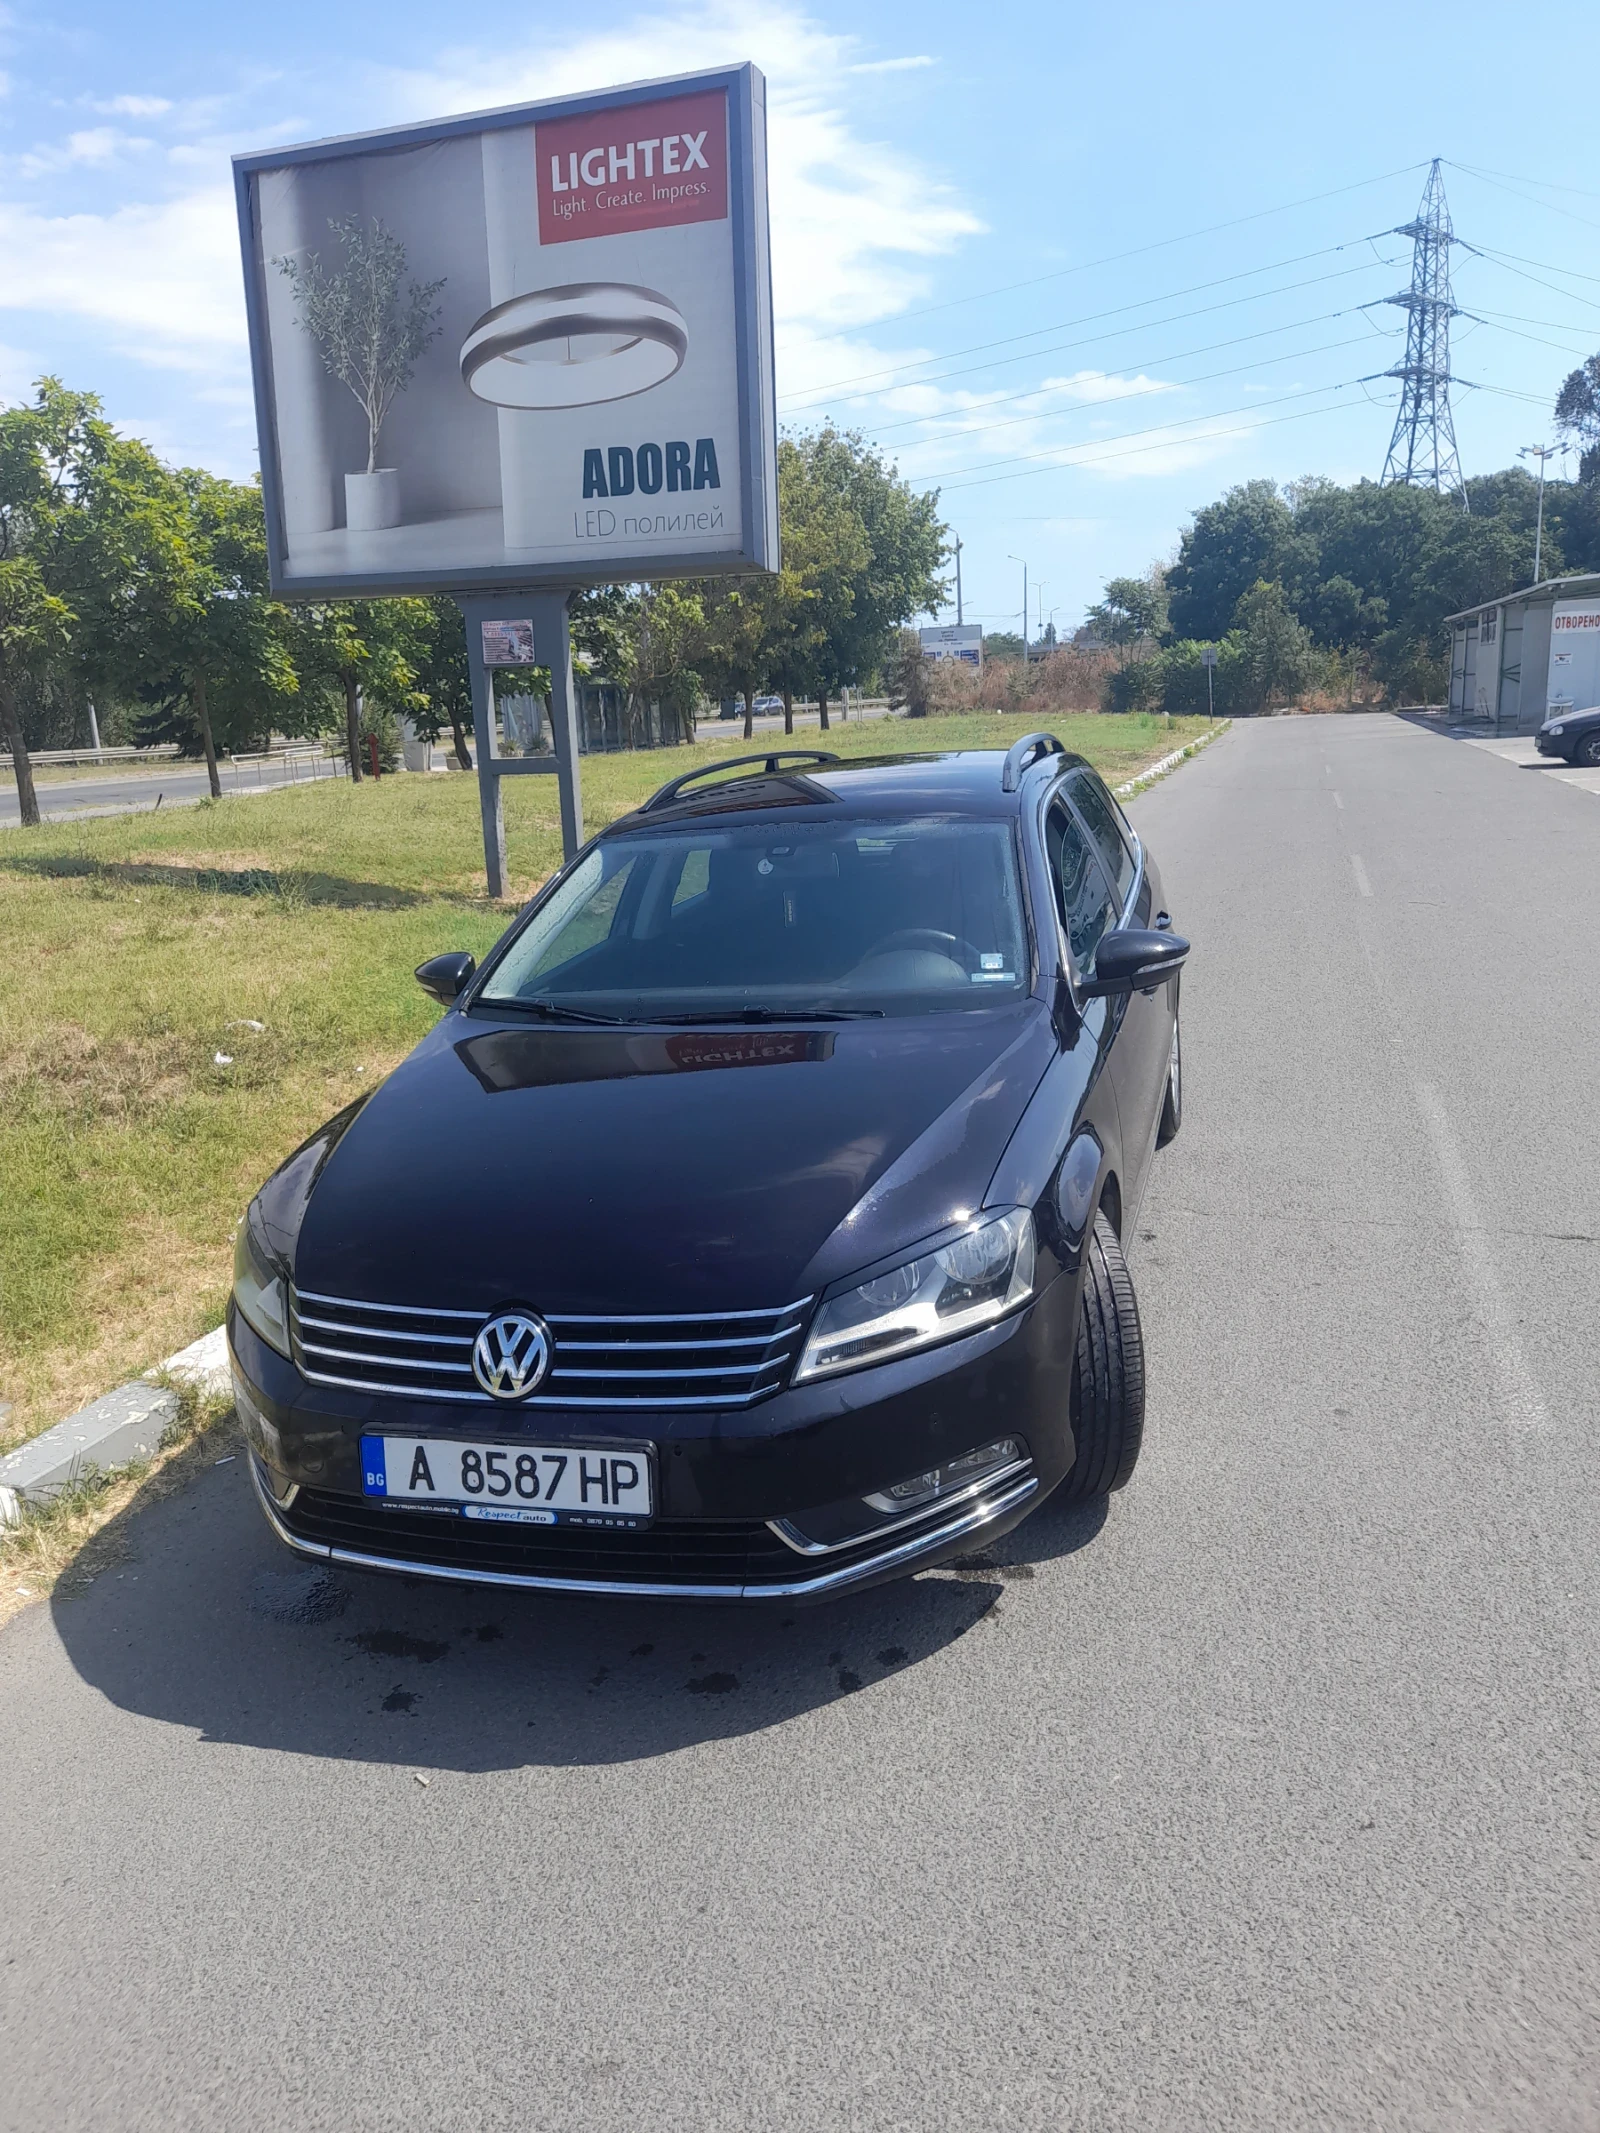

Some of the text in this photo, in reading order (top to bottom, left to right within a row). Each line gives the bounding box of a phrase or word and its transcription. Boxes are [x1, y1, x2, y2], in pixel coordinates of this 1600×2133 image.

[551, 131, 710, 192] LIGHTEX
[553, 181, 711, 220] Light. Create. Impress.
[582, 438, 721, 499] ADORA
[574, 505, 724, 538] LED полилей
[1555, 614, 1600, 630] ОТВОРЕНО
[366, 1445, 639, 1506] BG A 8587 HP
[476, 1506, 527, 1519] Respect
